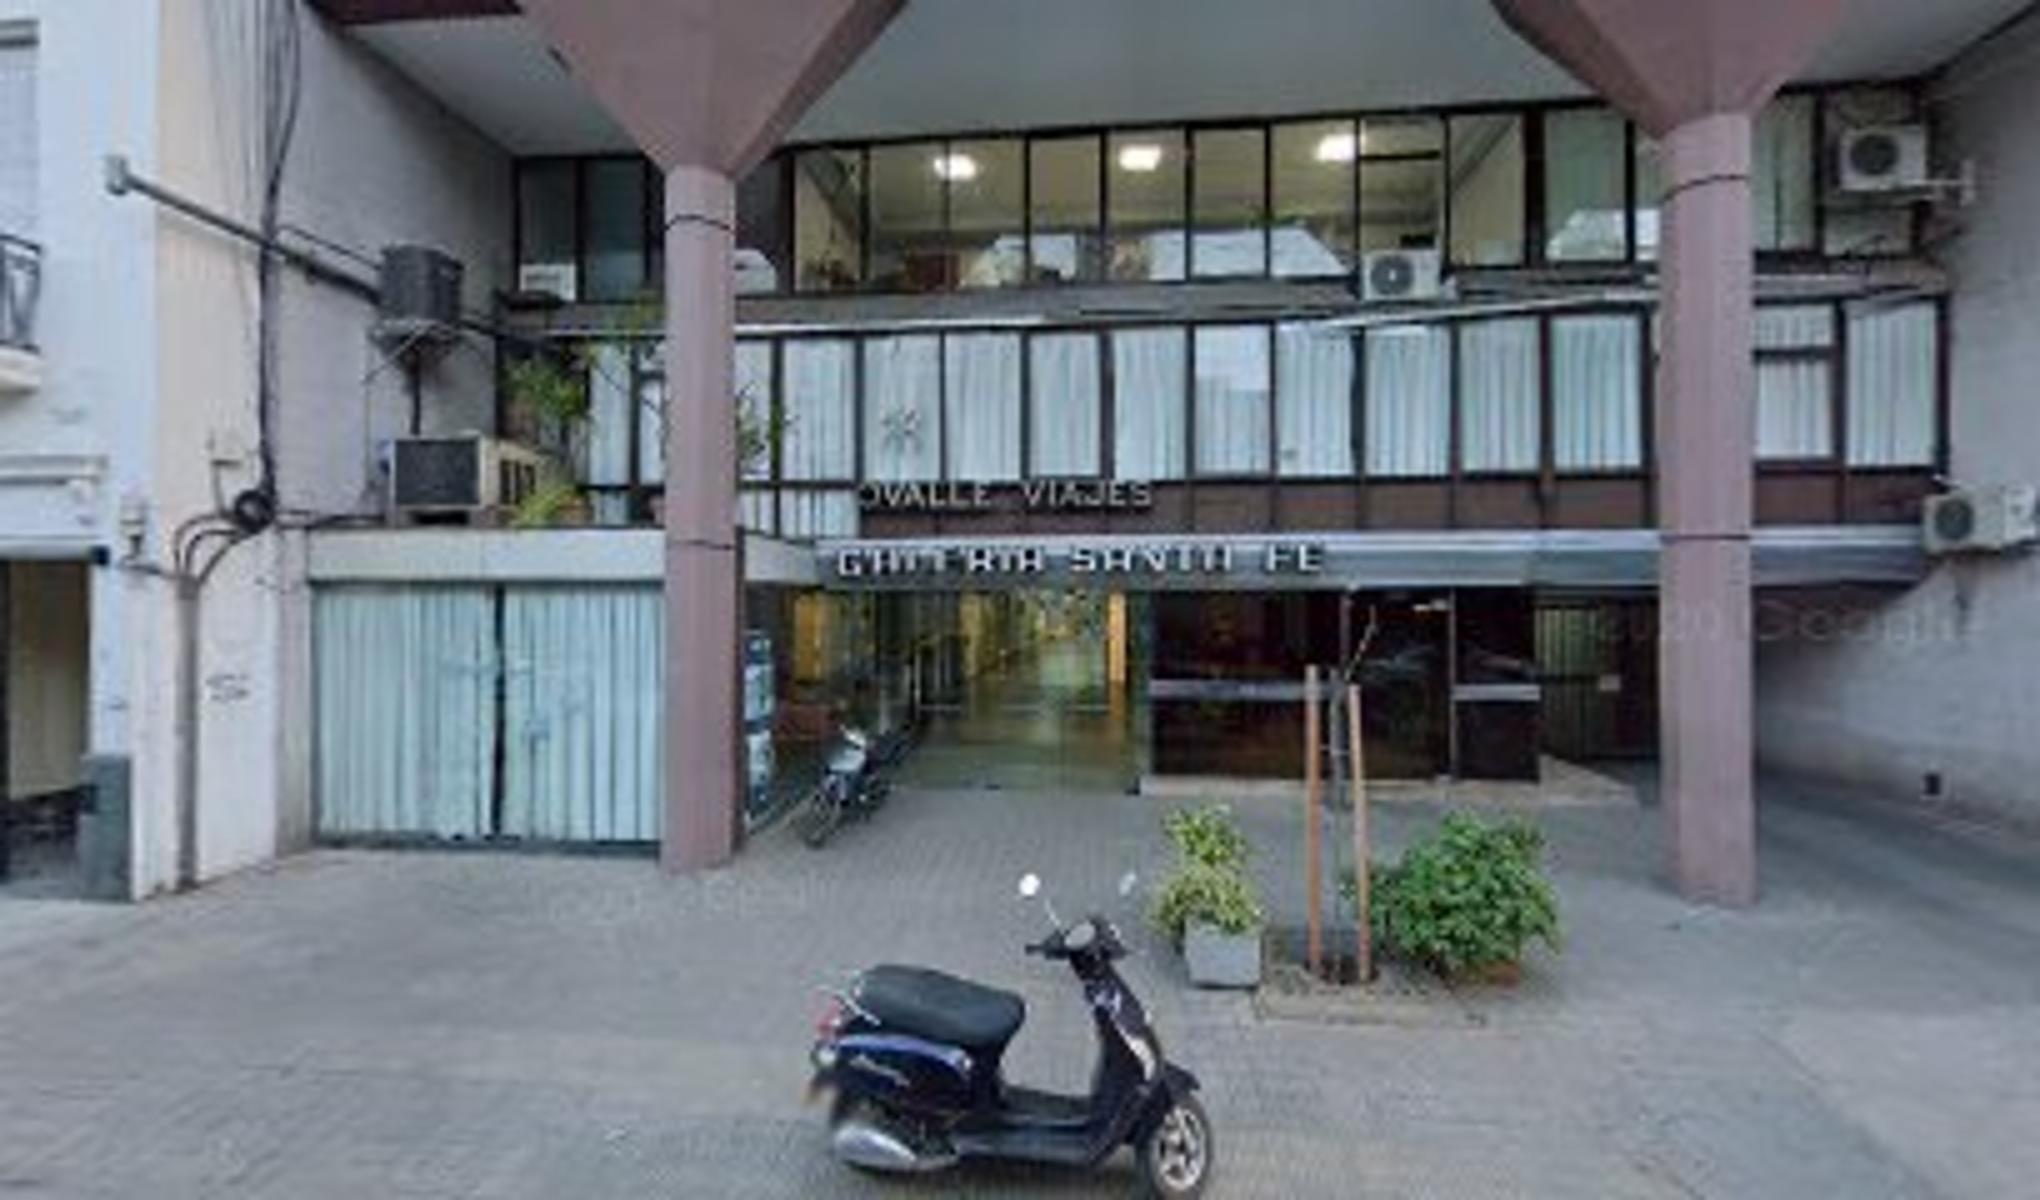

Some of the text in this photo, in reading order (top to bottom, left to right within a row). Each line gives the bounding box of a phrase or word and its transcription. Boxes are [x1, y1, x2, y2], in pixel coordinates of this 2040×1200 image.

[1023, 479, 1153, 507] VIAJES
[1070, 544, 1233, 573] SANTA
[1266, 542, 1325, 573] FE
